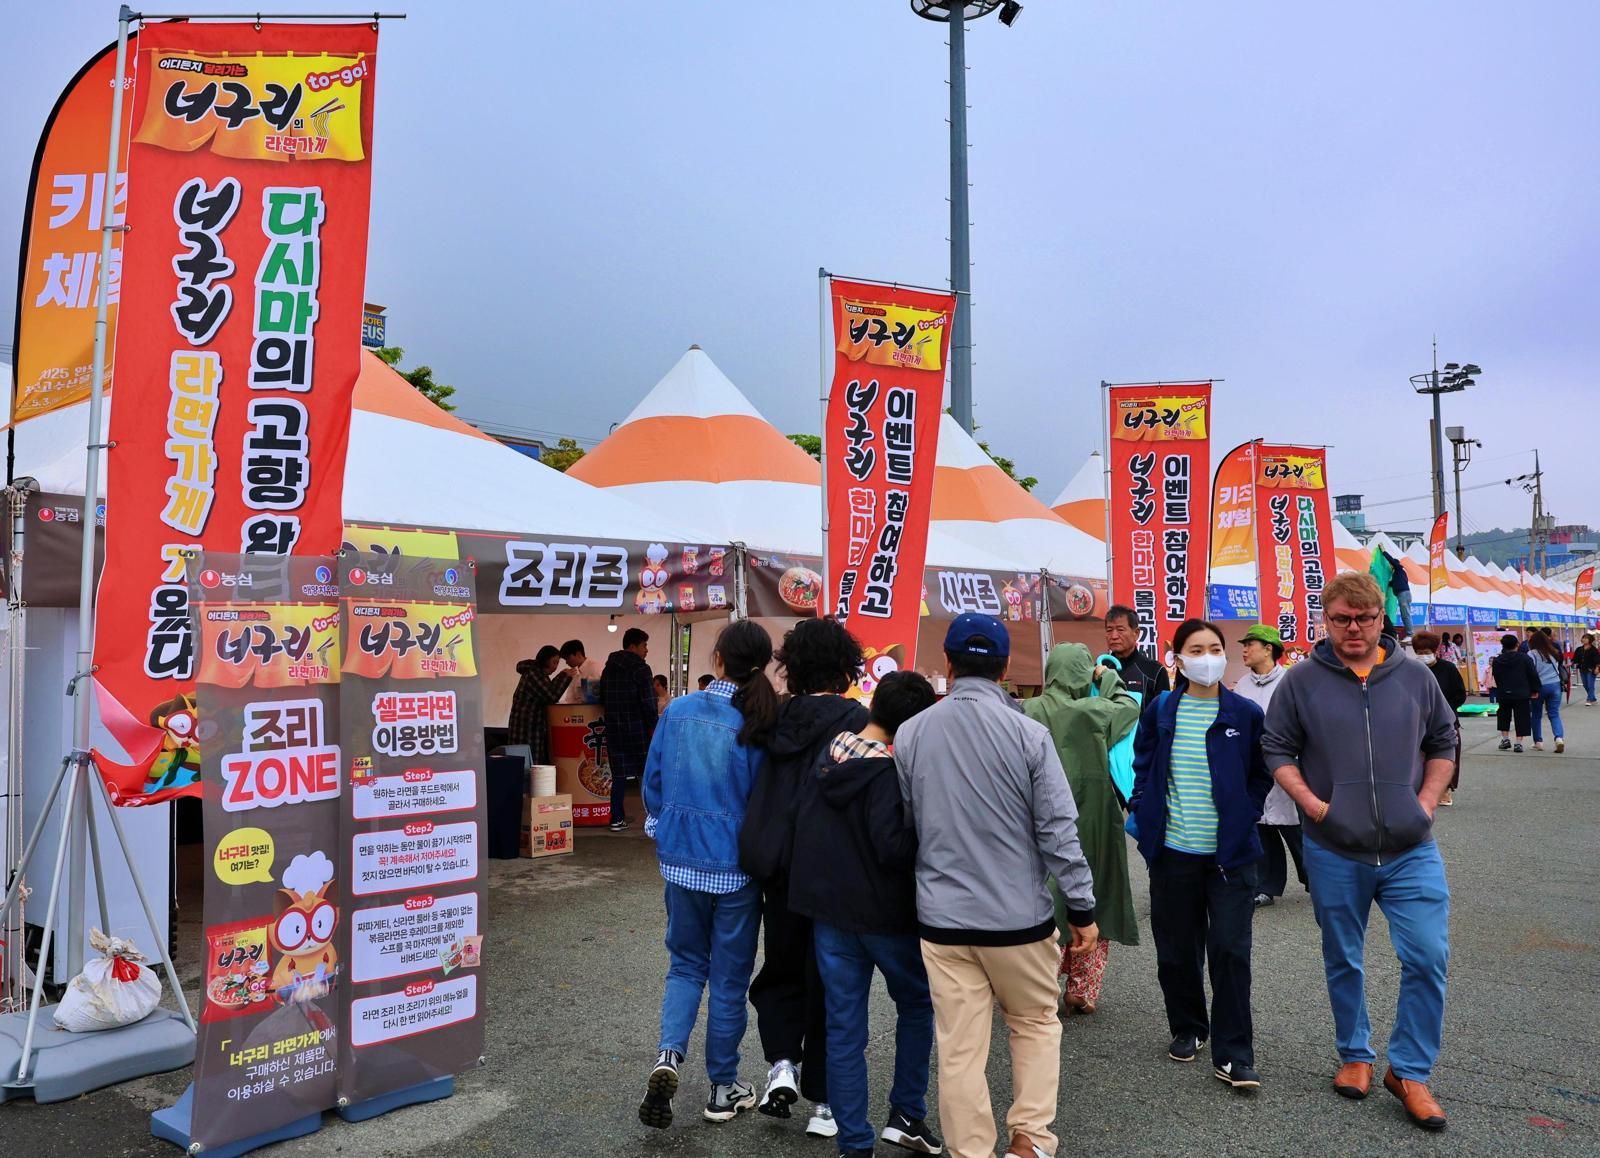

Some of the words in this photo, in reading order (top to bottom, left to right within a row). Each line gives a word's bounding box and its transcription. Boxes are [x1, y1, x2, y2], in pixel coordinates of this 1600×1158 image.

[160, 59, 202, 72] 어디든지
[308, 60, 368, 89] to-go!
[265, 135, 329, 153] 라면가게
[49, 172, 127, 230] 키
[172, 177, 240, 345] 너구리
[249, 187, 325, 391] 다시마의
[918, 315, 947, 331] to-go!
[1181, 399, 1207, 412] to-go!
[845, 380, 878, 481] 너구리
[883, 387, 916, 484] 이벤트
[241, 398, 309, 510] 고향
[1129, 452, 1155, 525] 너구리
[1163, 455, 1190, 524] 이벤트
[1269, 494, 1291, 544] 너구리
[1296, 495, 1321, 557] 다시마의
[859, 490, 909, 618] 참여하고
[1131, 531, 1154, 586] 한마리
[221, 572, 253, 586] 농심
[366, 571, 393, 585] 농심
[501, 544, 627, 604] 조리존
[1163, 529, 1189, 621] 참여하고
[1301, 558, 1325, 591] 고향
[302, 584, 340, 596] 해양치유완
[940, 575, 1000, 612] 시식존
[208, 611, 238, 620] 어디든지
[354, 607, 380, 616] 어디든지
[442, 609, 474, 629] to-go!
[288, 665, 329, 678] 라면가게
[421, 660, 457, 672] 라면가게
[375, 694, 454, 723] 셀프라면
[248, 703, 321, 752] 조리
[376, 725, 455, 752] 이용방법
[228, 752, 338, 804] ZONE
[404, 770, 432, 781] Step1
[373, 789, 396, 799] 원하는
[397, 786, 419, 797] 라면을
[420, 782, 460, 795] 푸드트럭에서
[388, 798, 411, 811] 골라서
[572, 807, 590, 817] 생을
[405, 822, 432, 834] Step2
[219, 845, 249, 861] 너구리
[251, 844, 270, 856] 맛집!
[359, 845, 375, 857] 면을
[376, 843, 399, 854] 익히는
[401, 841, 415, 851] 동안
[417, 839, 430, 850] 물이
[432, 837, 446, 848] 끓기
[446, 834, 472, 845] 시작하면
[390, 854, 420, 865] 계속해서
[421, 848, 457, 861] 저어주세요!
[230, 859, 259, 872] 여기는?
[361, 870, 378, 882] 젓지
[378, 868, 401, 880] 않으면
[403, 865, 425, 876] 바닥이
[434, 862, 441, 872] 수
[405, 896, 433, 908] Step3
[393, 915, 415, 928] 신라면
[431, 911, 439, 921] 등
[440, 907, 460, 919] 국물이
[460, 905, 473, 916] 없는
[368, 930, 408, 944] 볶음라면은
[409, 924, 444, 937] 후레이크를
[445, 918, 465, 930] 제외한
[217, 943, 264, 968] 너구리
[380, 942, 403, 955] 스프를
[404, 940, 412, 951] 꼭
[413, 936, 441, 949] 마지막에
[400, 949, 438, 964] 비벼드세요!
[406, 982, 433, 995] Step4
[362, 1009, 380, 1020] 라면
[380, 1006, 396, 1018] 조리
[397, 1003, 405, 1014] 전
[406, 999, 428, 1012] 조리기
[428, 995, 442, 1007] 위의
[383, 1018, 399, 1029] 다시
[400, 1016, 407, 1026] 한
[408, 1013, 416, 1024] 번
[417, 1005, 452, 1022] 읽어주세요!
[230, 1045, 269, 1066] 너구리
[273, 1025, 336, 1055] 라면가게에서
[245, 1057, 290, 1080] 구매하신
[294, 1046, 326, 1066] 제품만
[227, 1078, 274, 1100] 이용하실
[279, 1074, 290, 1087] 수
[294, 1059, 337, 1083] 있습니다.
